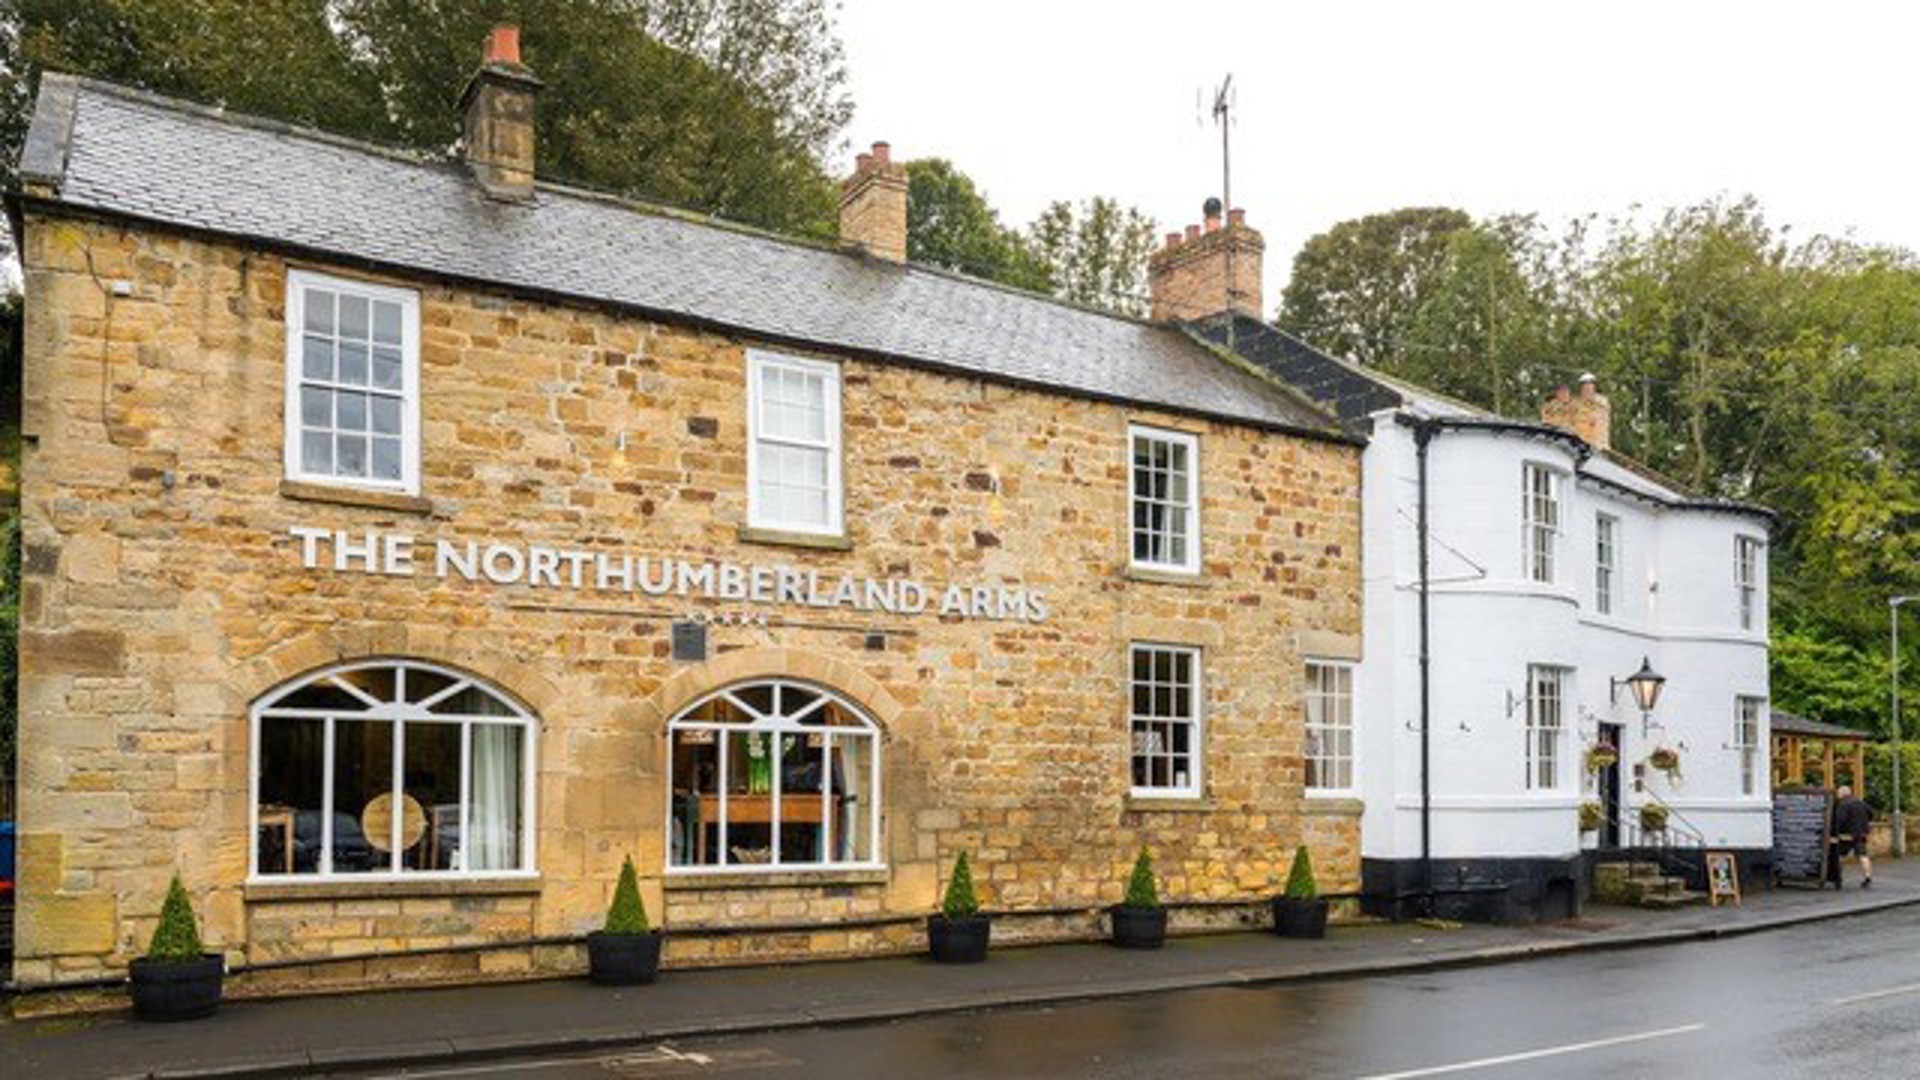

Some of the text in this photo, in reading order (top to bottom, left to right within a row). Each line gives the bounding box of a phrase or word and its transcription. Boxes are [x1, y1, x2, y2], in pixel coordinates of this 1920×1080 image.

[290, 526, 1050, 623] THE NORTHUMBERLAND ARMS
